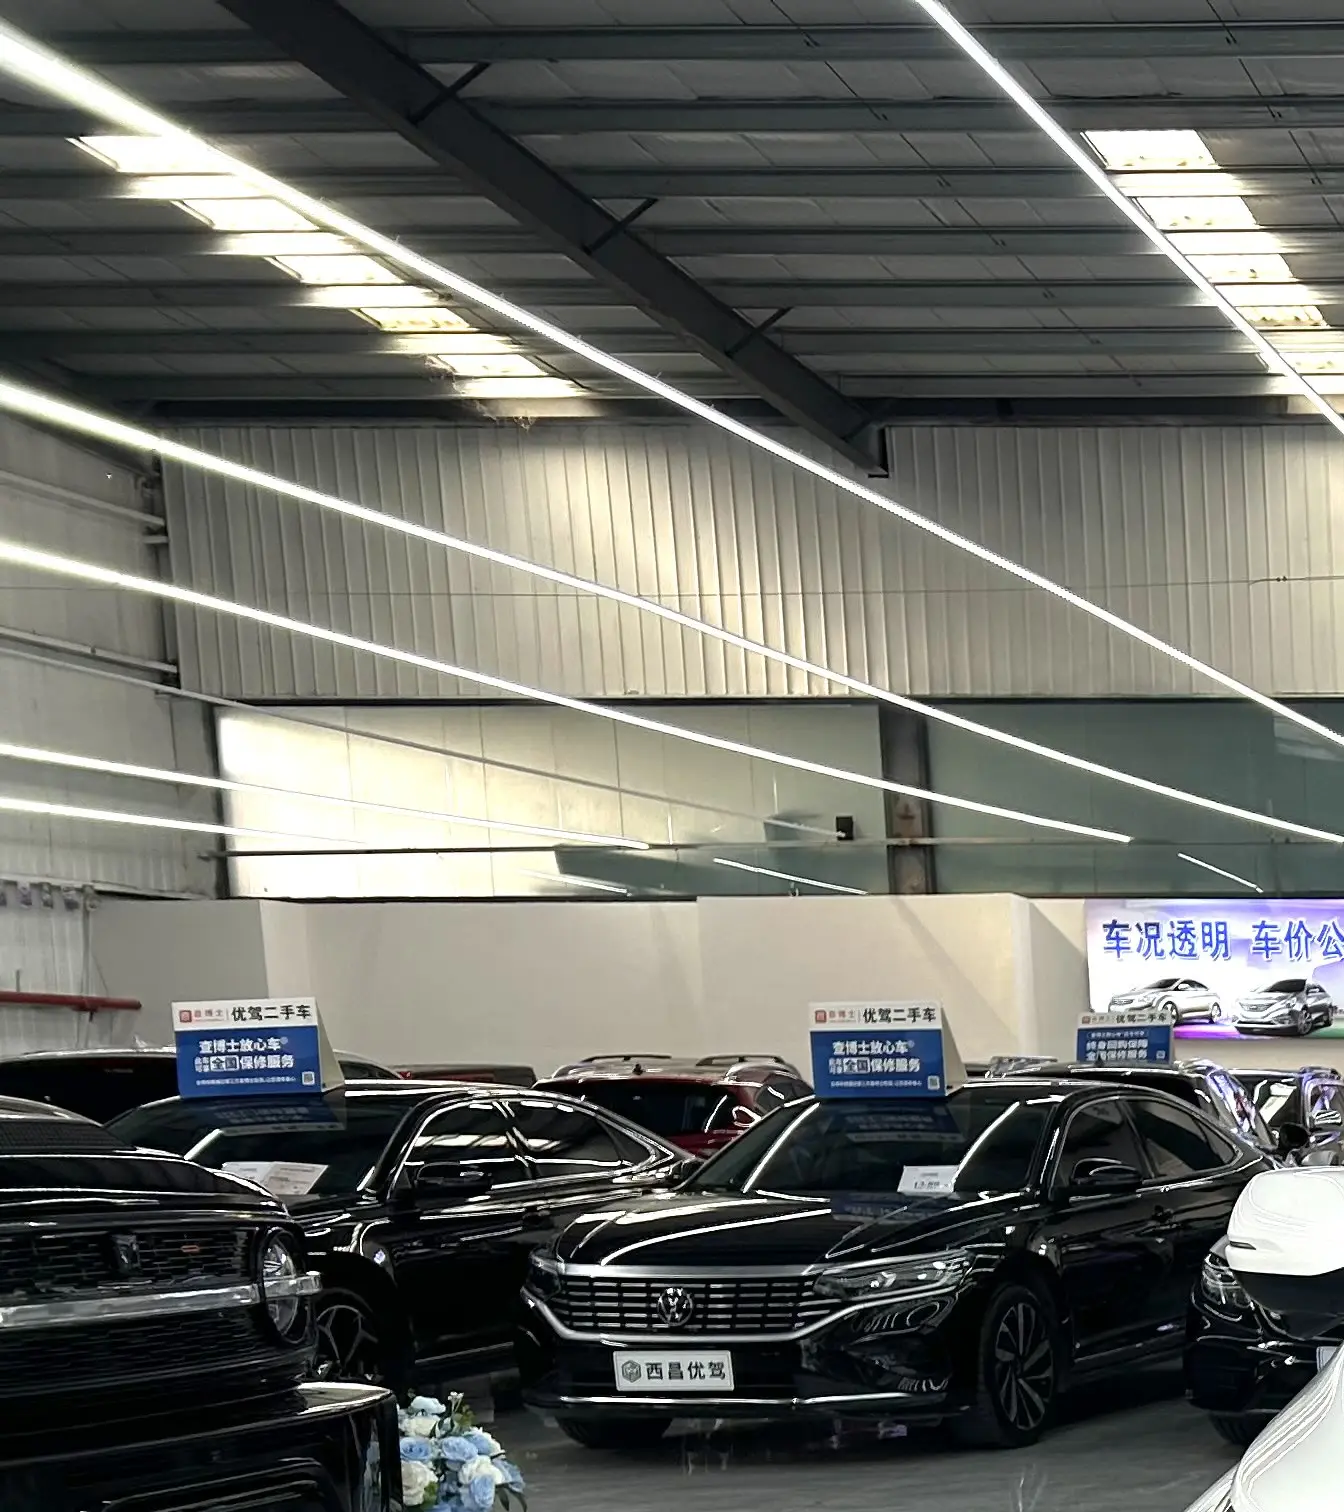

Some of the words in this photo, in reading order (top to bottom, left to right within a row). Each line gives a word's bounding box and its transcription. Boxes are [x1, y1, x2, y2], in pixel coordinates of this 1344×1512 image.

[1102, 919, 1231, 960] 车况透明
[231, 1004, 311, 1022] 优驾二手车
[863, 1007, 937, 1023] 优驾二手车
[645, 1361, 725, 1380] 西昌优驾
